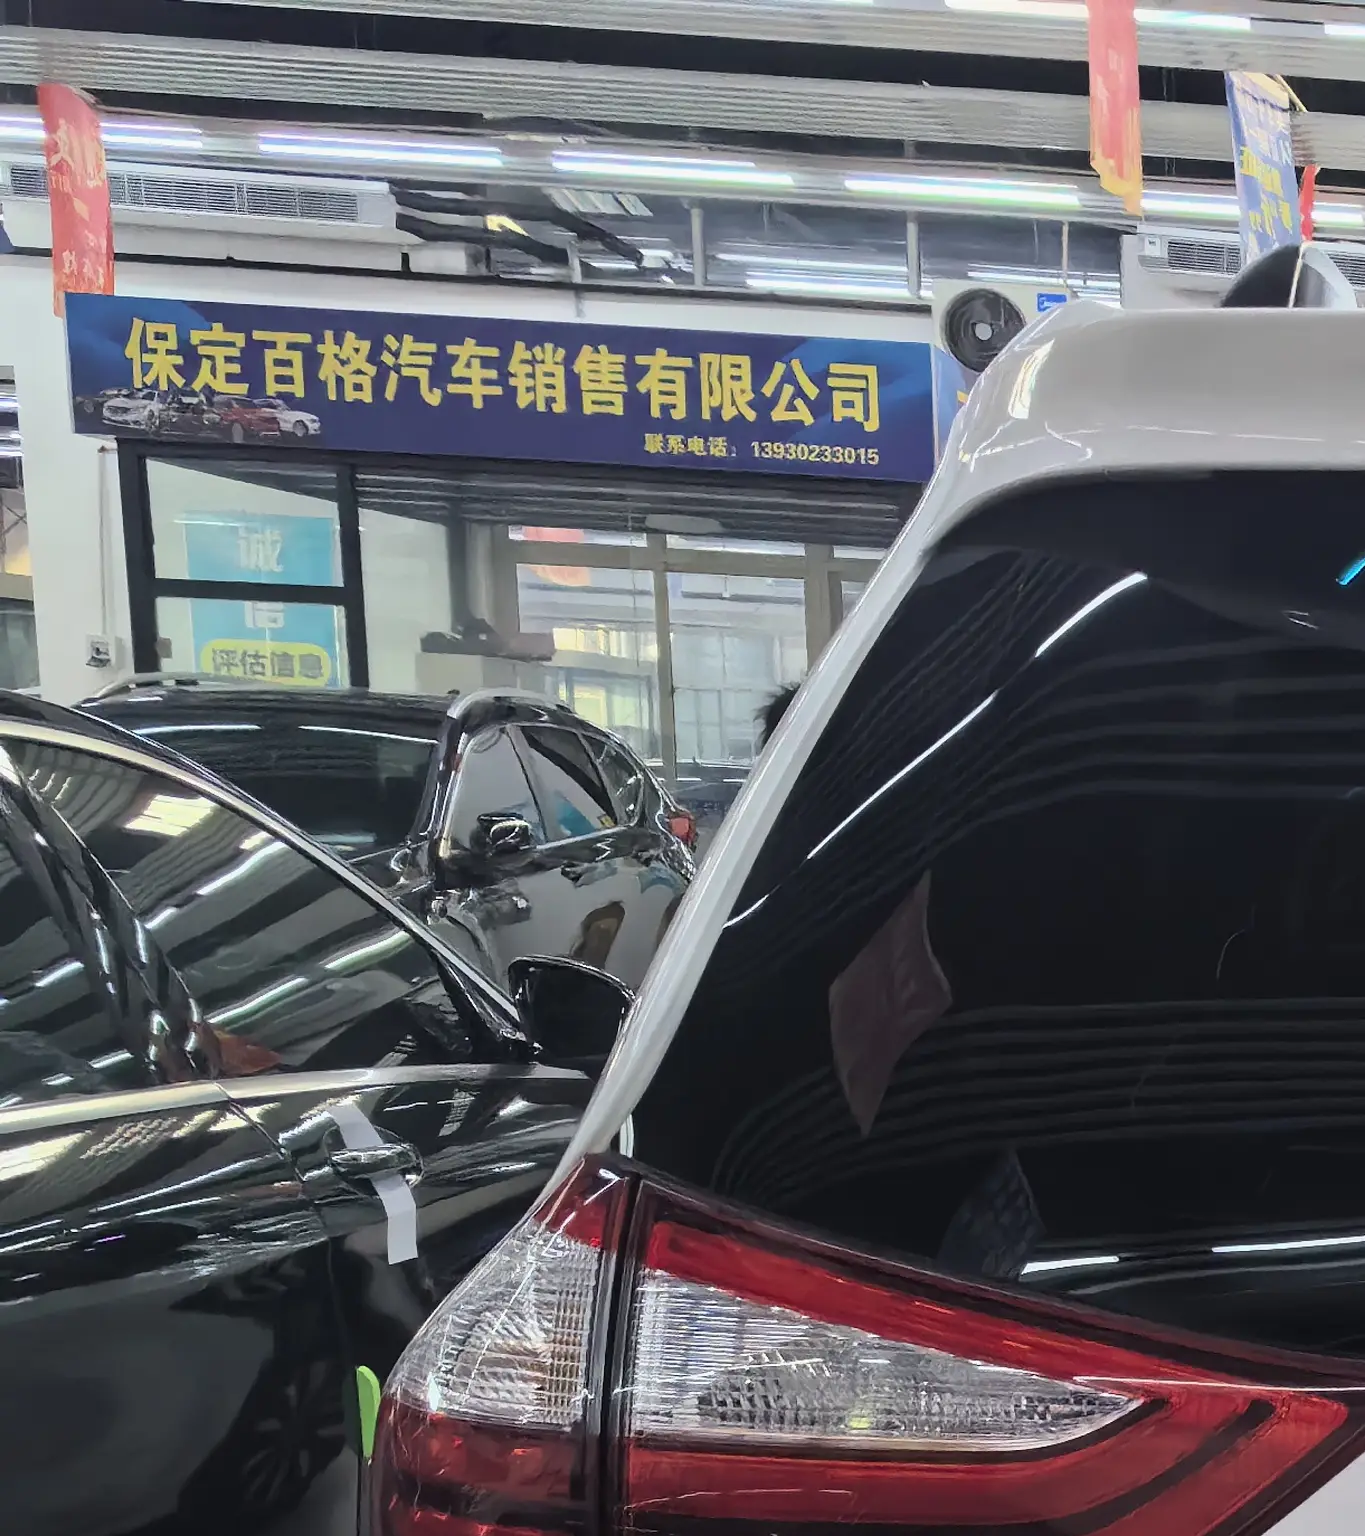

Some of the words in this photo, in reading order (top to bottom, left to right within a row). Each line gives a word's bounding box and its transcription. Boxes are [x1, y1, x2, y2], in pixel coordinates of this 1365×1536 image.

[124, 316, 882, 432] 保定百格汽车销售有限公司
[751, 441, 880, 466] 13930233015
